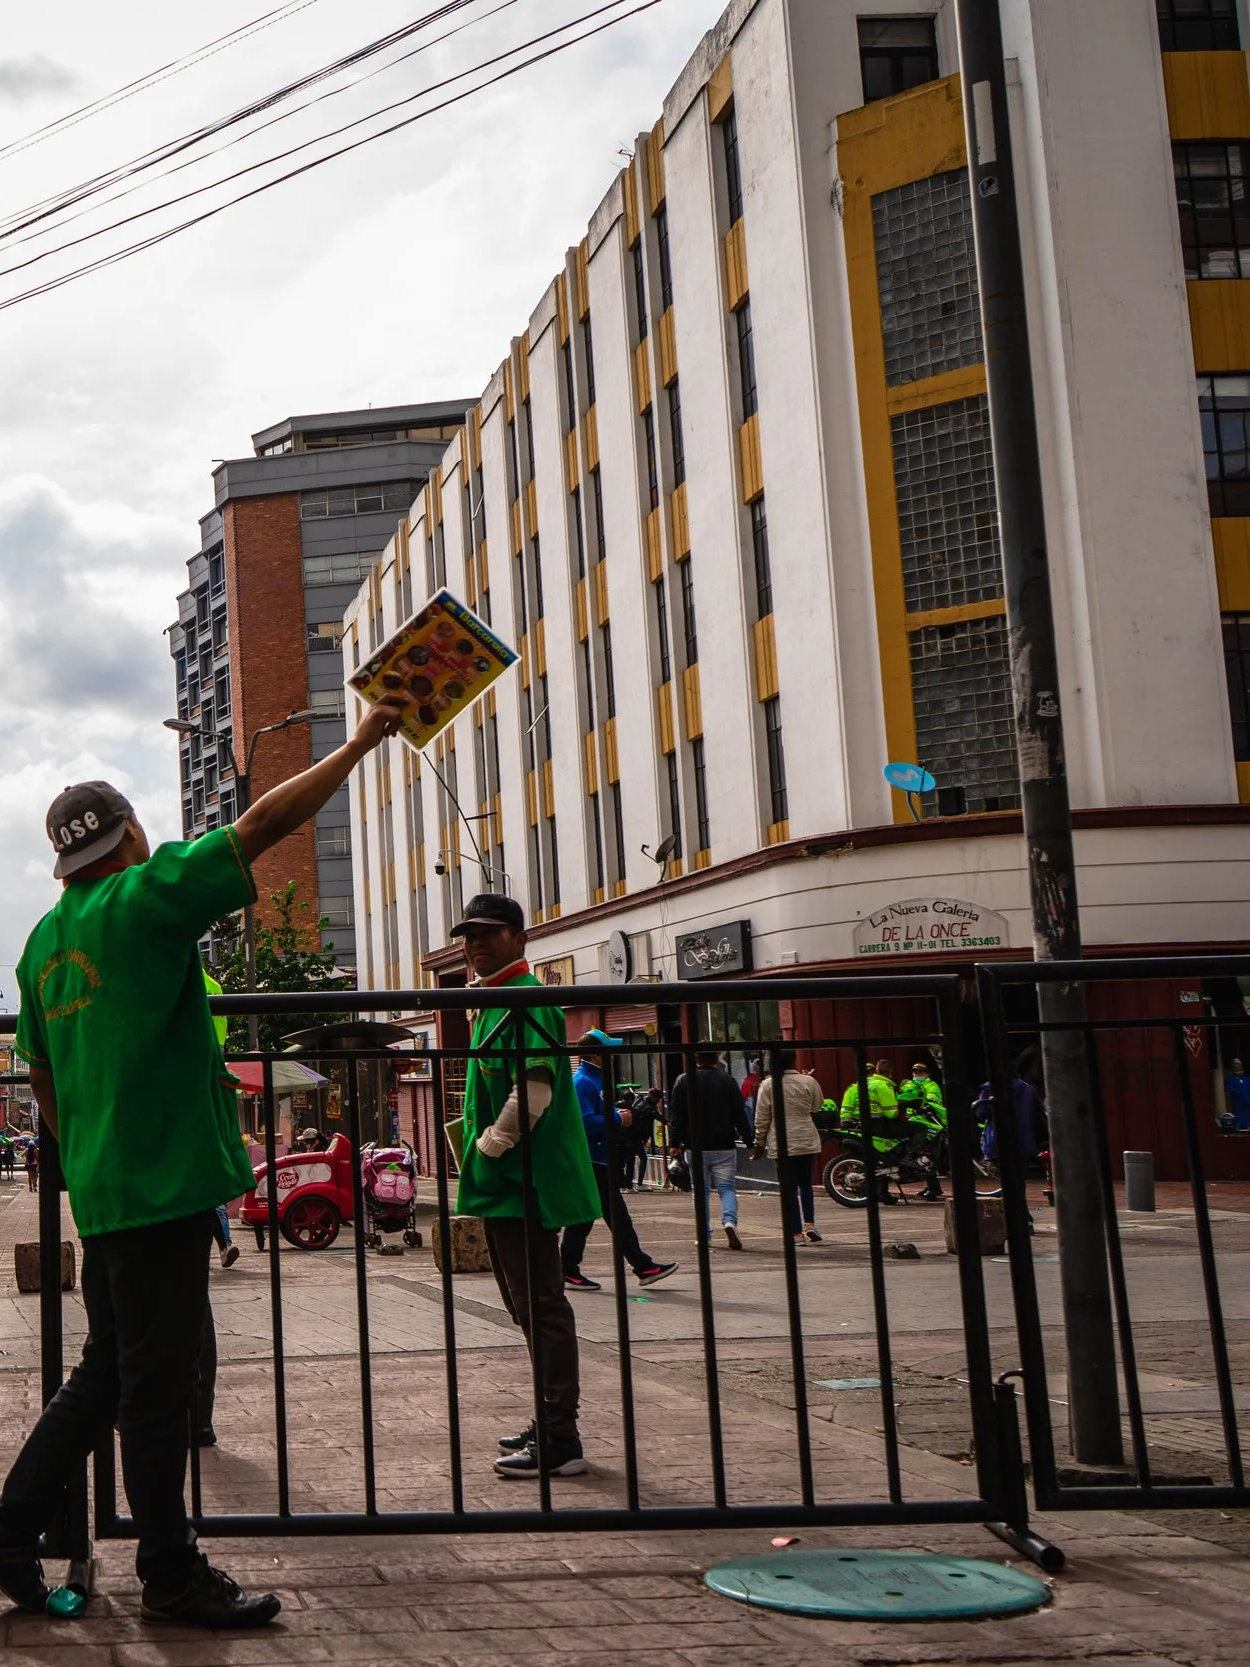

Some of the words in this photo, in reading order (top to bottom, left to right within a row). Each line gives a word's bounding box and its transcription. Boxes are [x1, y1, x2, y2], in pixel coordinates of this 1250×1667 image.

[50, 811, 99, 850] Lose
[869, 915, 888, 929] La
[889, 904, 929, 920] Nueva
[882, 926, 902, 942] DE
[905, 925, 925, 941] LA
[930, 922, 972, 939] ONCE
[859, 943, 891, 954] CARRERA
[894, 943, 900, 951] 9
[917, 940, 937, 950] 11-01
[961, 936, 1001, 947] 3363403
